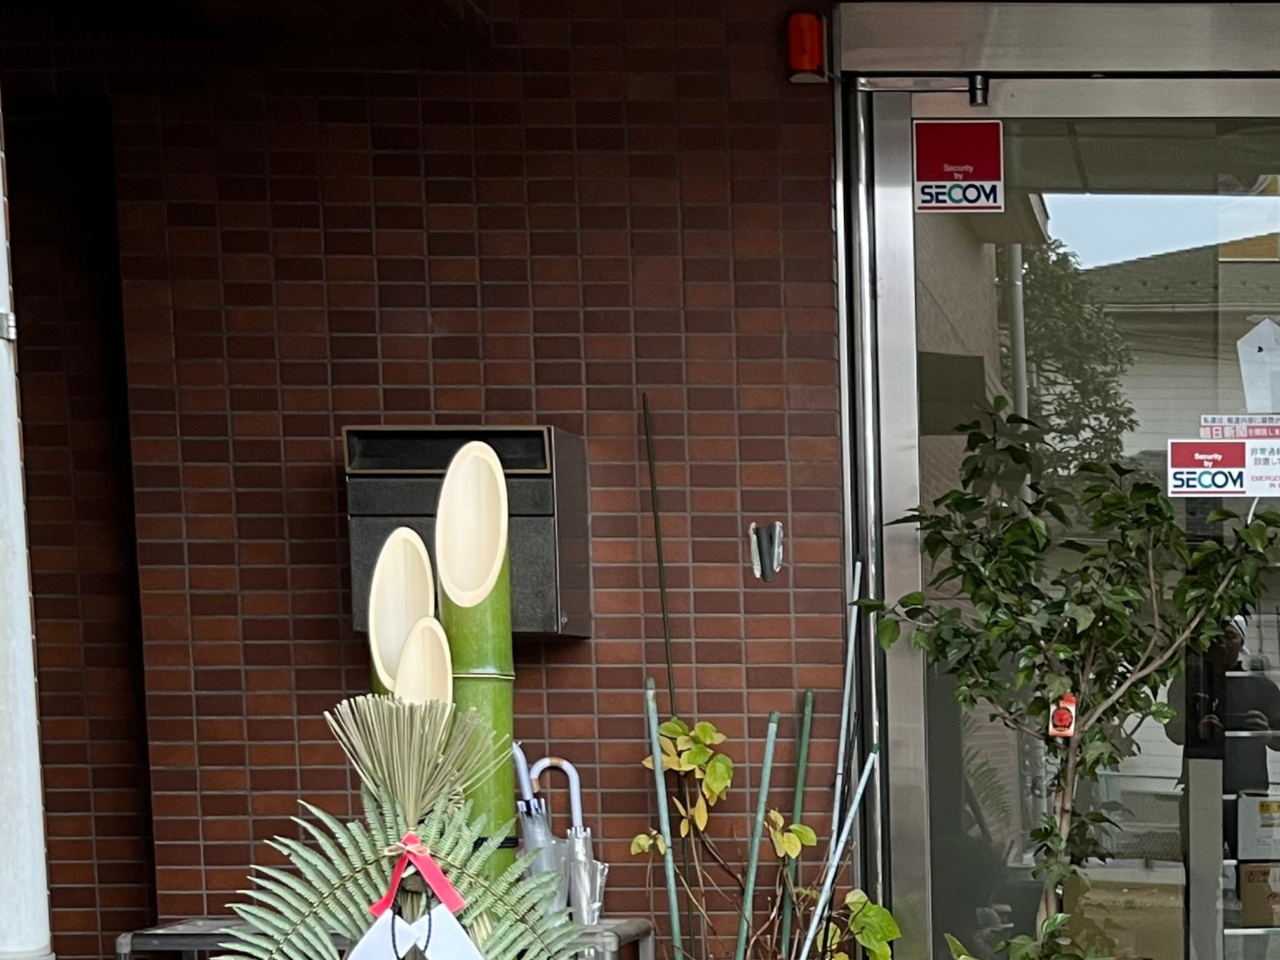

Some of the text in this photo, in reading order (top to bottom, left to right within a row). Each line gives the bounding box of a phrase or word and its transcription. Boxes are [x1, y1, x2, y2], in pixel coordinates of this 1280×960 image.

[943, 163, 974, 173] Security
[953, 172, 964, 180] by
[920, 183, 998, 204] SECOM
[1193, 452, 1223, 462] Security
[1203, 460, 1214, 468] by
[1172, 470, 1244, 489] SECOM
